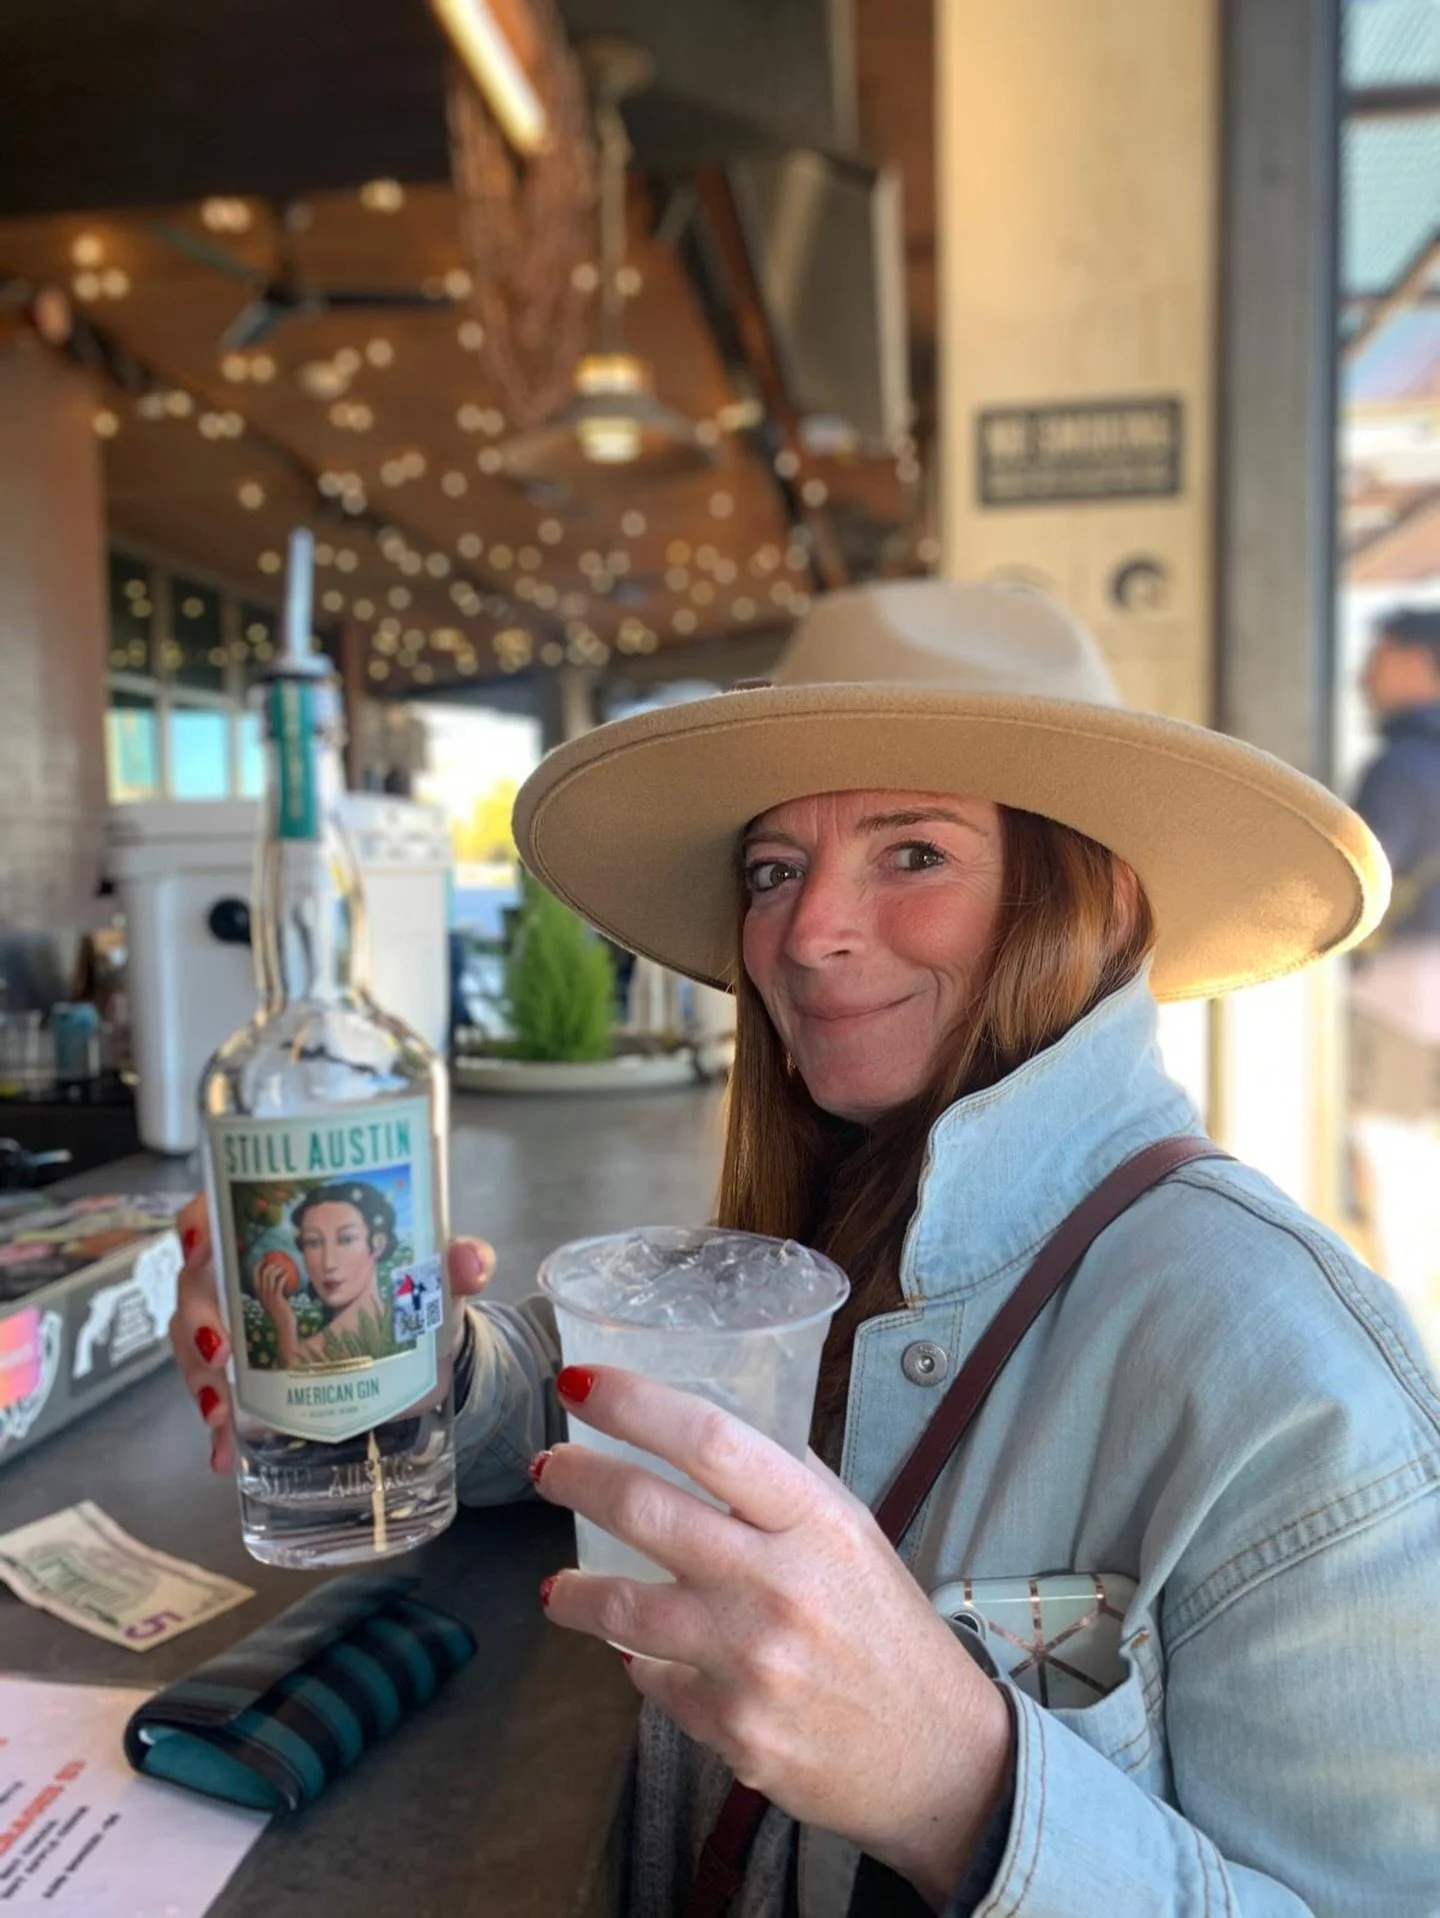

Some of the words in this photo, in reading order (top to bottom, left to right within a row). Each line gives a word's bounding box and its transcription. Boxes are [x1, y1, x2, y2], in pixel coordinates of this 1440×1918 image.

[224, 1133, 296, 1174] STILL
[309, 1119, 411, 1172] AUSTIN
[286, 1382, 354, 1406] AMERICAN
[357, 1376, 380, 1400] GIN
[124, 1610, 186, 1641] 5
